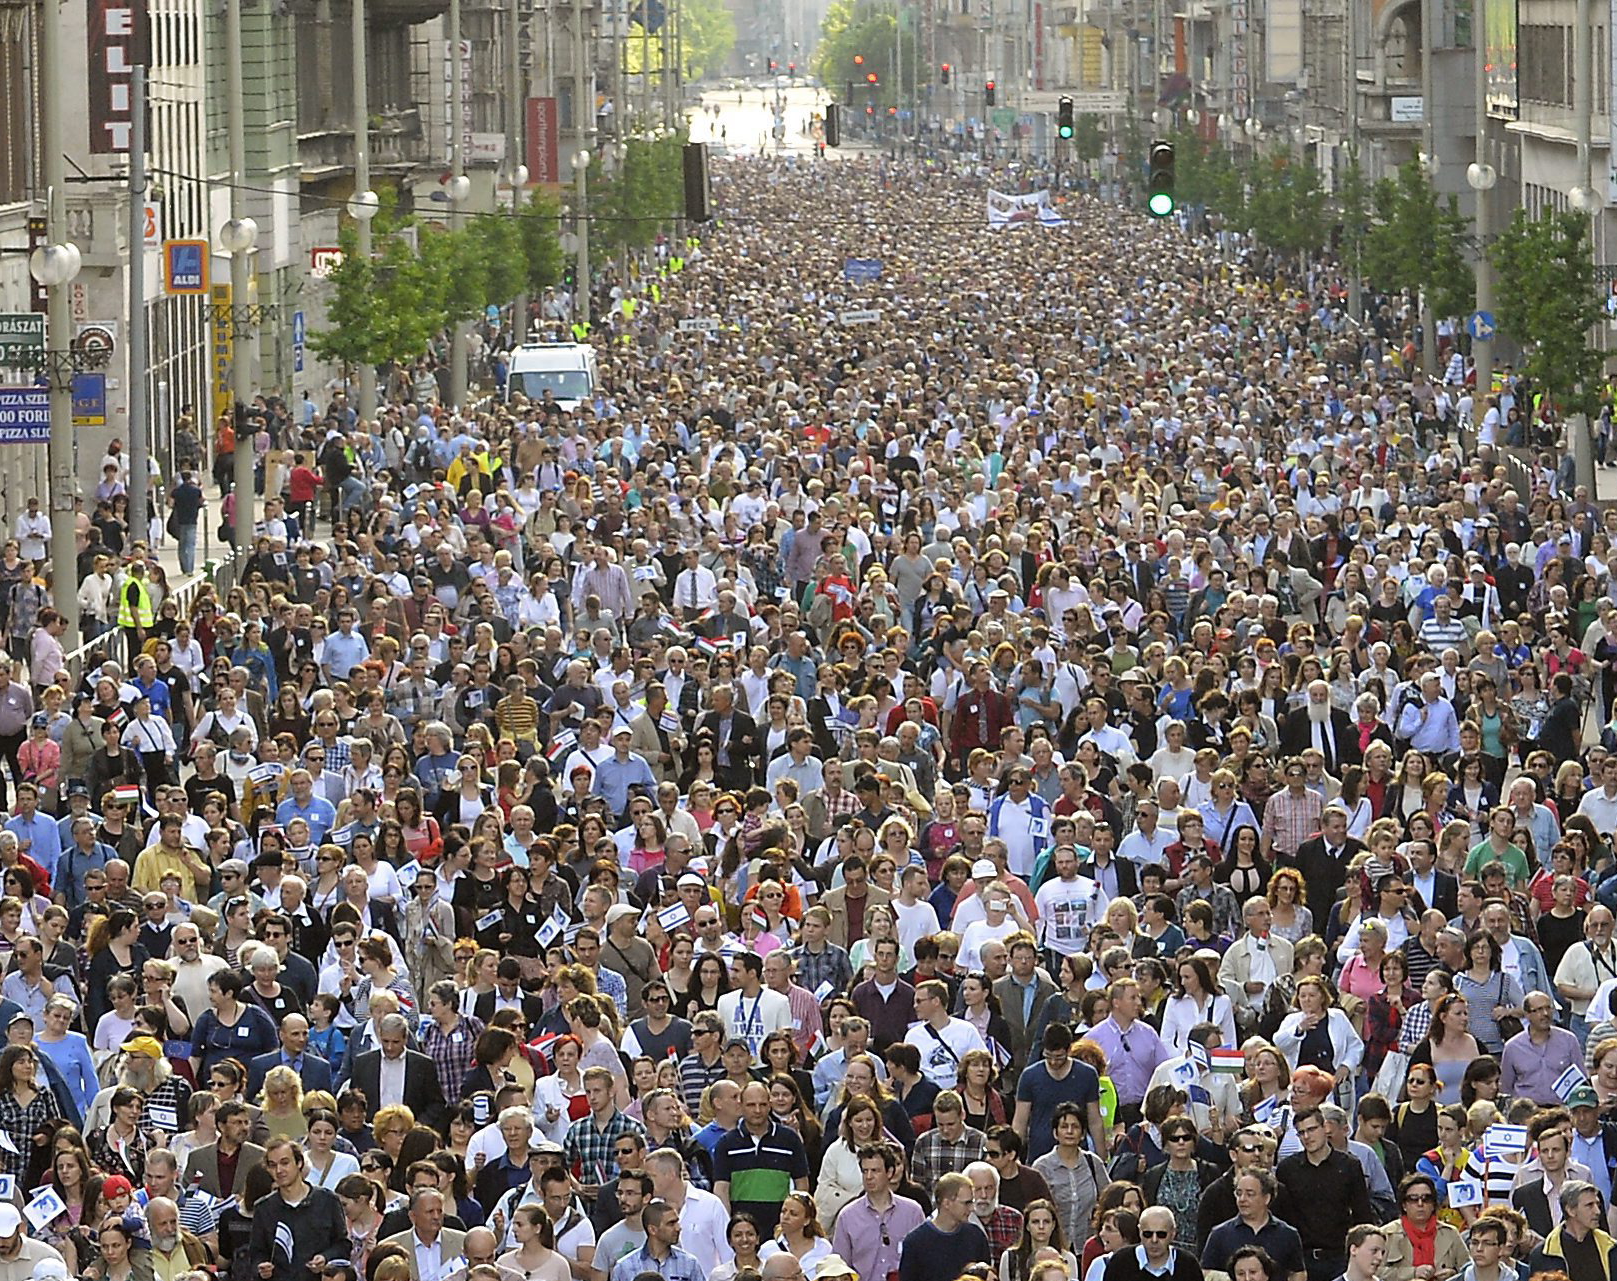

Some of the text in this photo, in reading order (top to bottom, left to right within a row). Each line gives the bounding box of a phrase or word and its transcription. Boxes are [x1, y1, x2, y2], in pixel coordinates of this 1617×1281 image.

[104, 8, 133, 149] ELIT
[172, 274, 200, 286] ALDI
[18, 411, 51, 423] FORI
[0, 427, 29, 439] PIZZA
